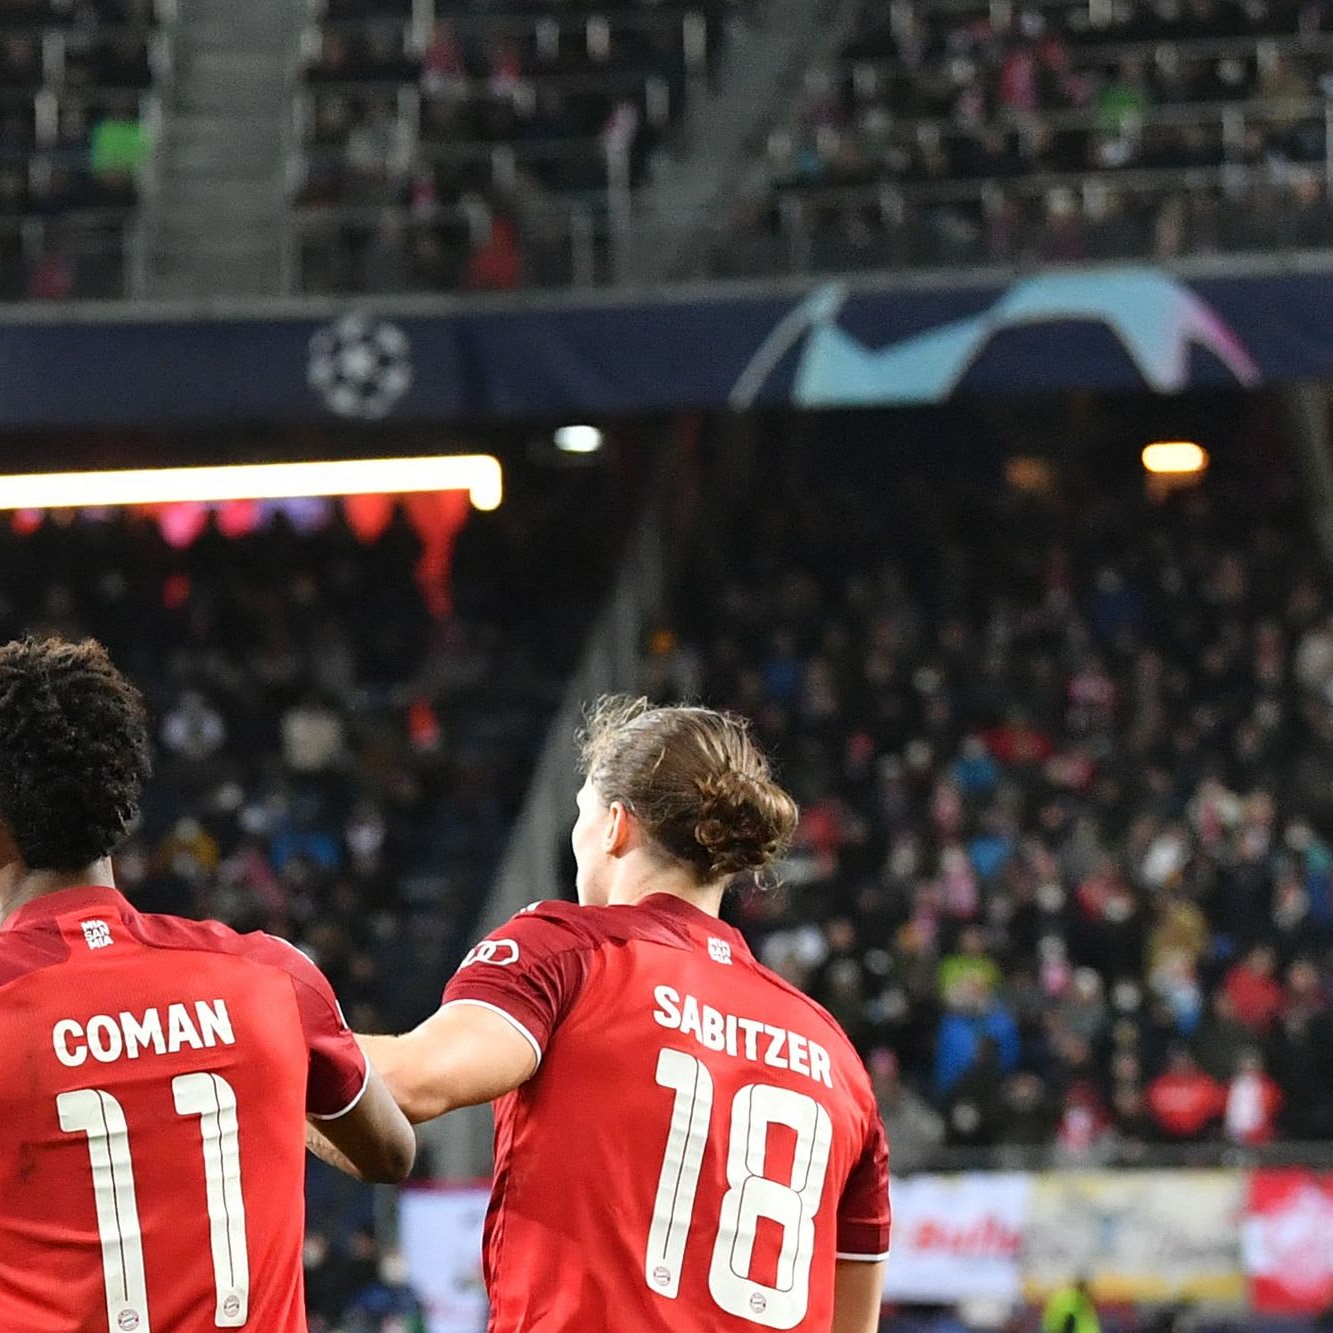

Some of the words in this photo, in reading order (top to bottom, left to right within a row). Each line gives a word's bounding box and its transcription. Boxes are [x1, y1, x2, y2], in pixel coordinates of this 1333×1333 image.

[52, 999, 235, 1066] COMAN
[653, 985, 833, 1088] SABITZER
[645, 1047, 832, 1330] 18
